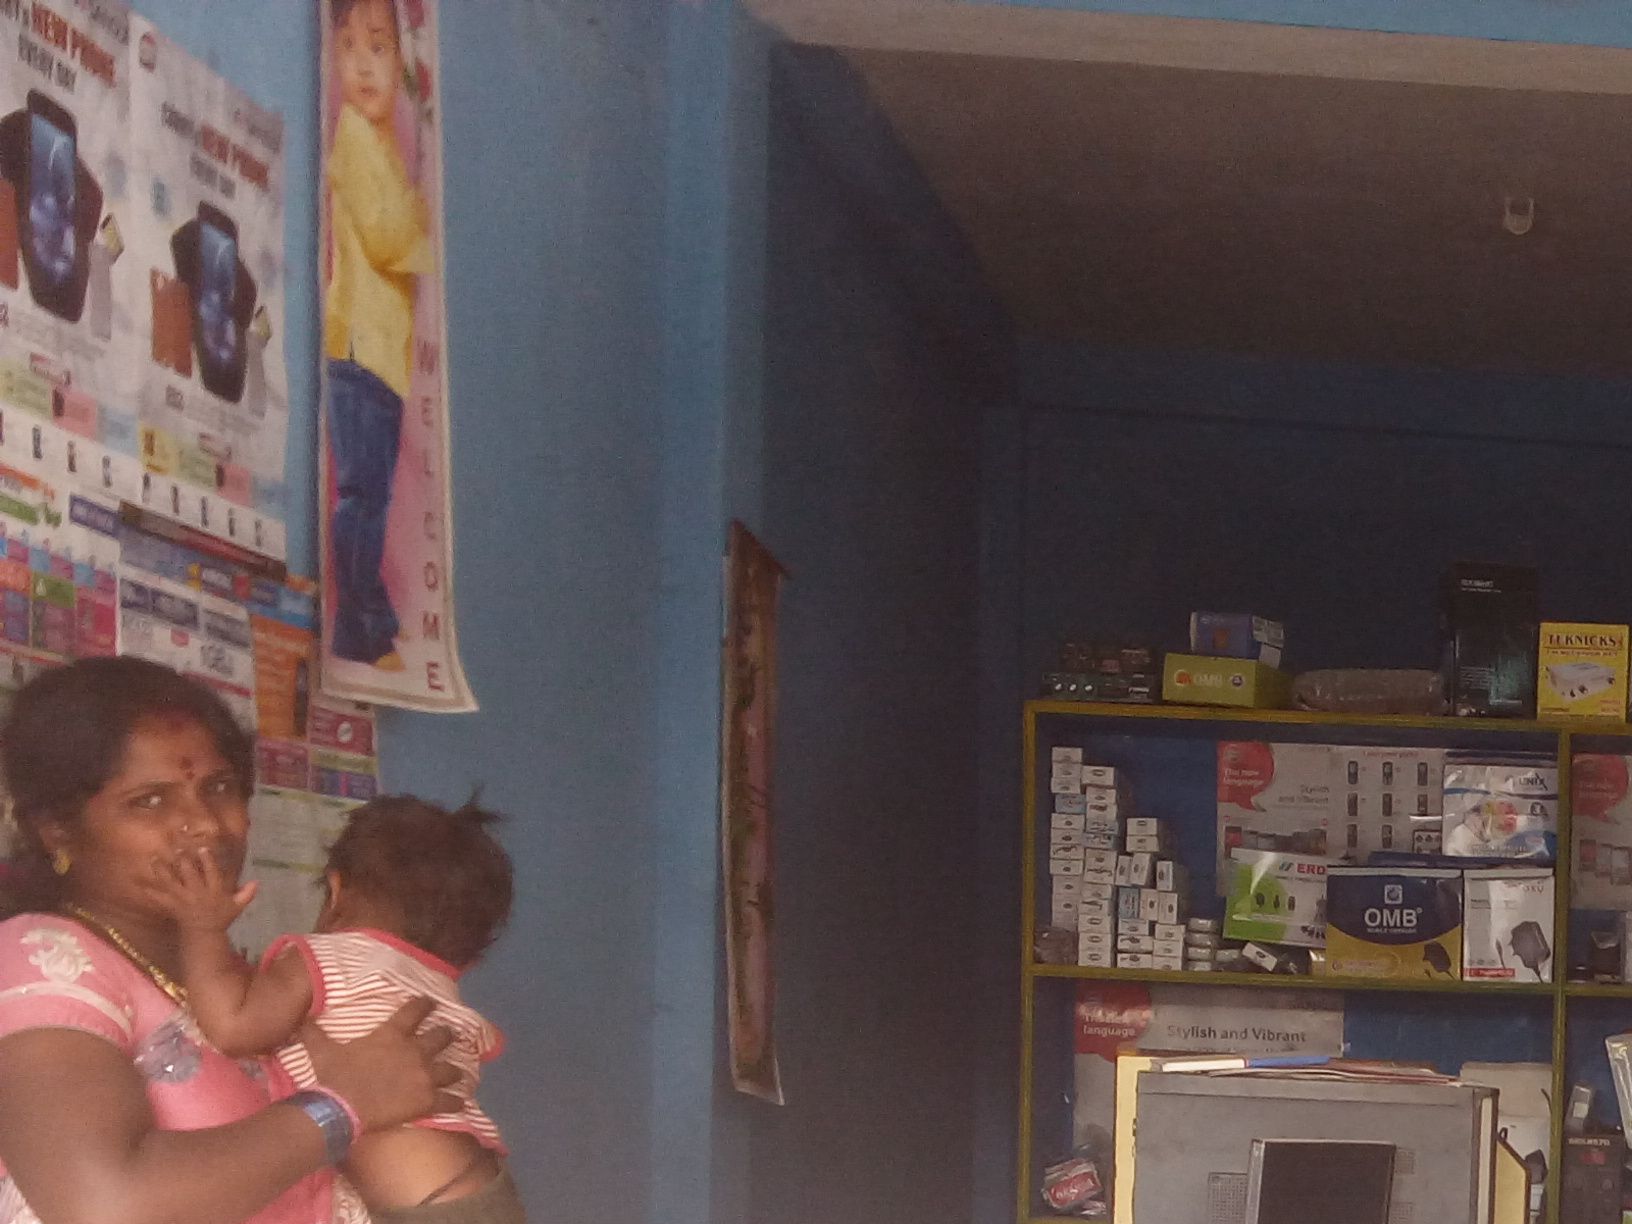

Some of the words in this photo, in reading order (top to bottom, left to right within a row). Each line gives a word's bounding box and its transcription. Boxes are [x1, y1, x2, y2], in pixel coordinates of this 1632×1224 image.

[1296, 864, 1327, 876] ERD
[1364, 907, 1418, 927] OMB
[1083, 1023, 1136, 1038] language
[1167, 1024, 1216, 1041] Stylish
[1219, 1028, 1248, 1040] and
[1250, 1028, 1307, 1043] Vibrant
